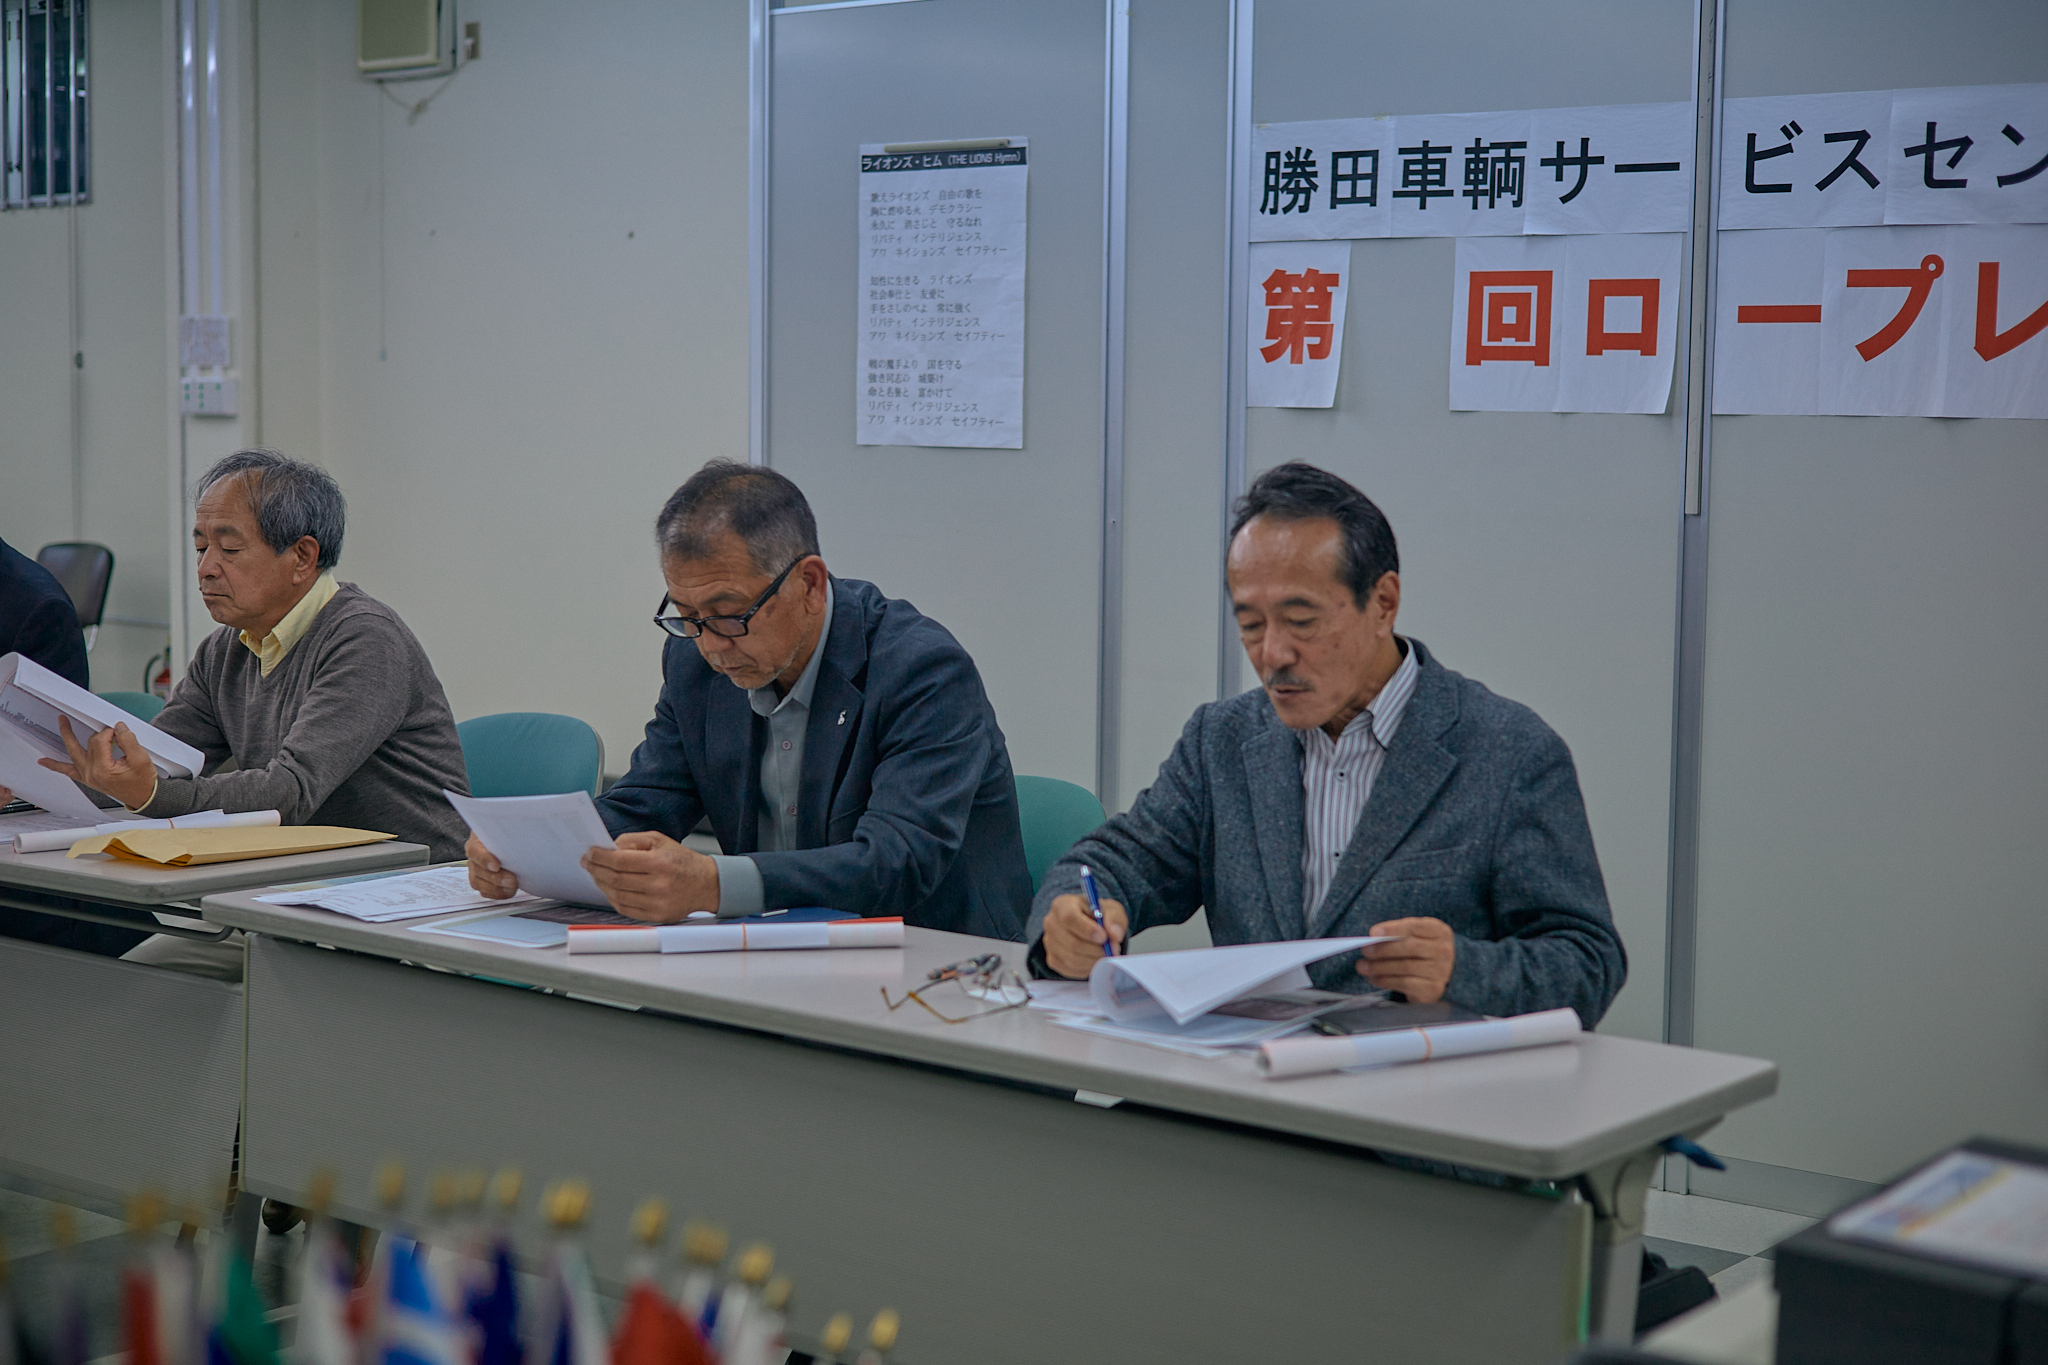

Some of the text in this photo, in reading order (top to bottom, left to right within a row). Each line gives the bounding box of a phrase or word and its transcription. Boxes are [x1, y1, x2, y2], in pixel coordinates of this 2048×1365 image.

[862, 155, 942, 171] ライオンズ・ヒム
[970, 153, 992, 164] LIONS
[939, 189, 982, 200] 自由の歌を
[929, 204, 982, 214] デモクラシー
[947, 217, 982, 229] 守るなれ
[913, 233, 982, 243] インテリジェンス
[871, 246, 1008, 258] アワ ネイションズ セイフティー
[929, 274, 973, 285] ライオンズ
[937, 302, 971, 313] 常に強く
[1260, 268, 1339, 364] 第
[911, 317, 981, 327] インテリジェンス
[870, 331, 1006, 342] アワ ネイションズ セイフティー
[927, 359, 962, 370] 国を守る
[911, 402, 979, 412] インテリジェンス
[868, 415, 1004, 428] アワ ネイションズ セイフティー
